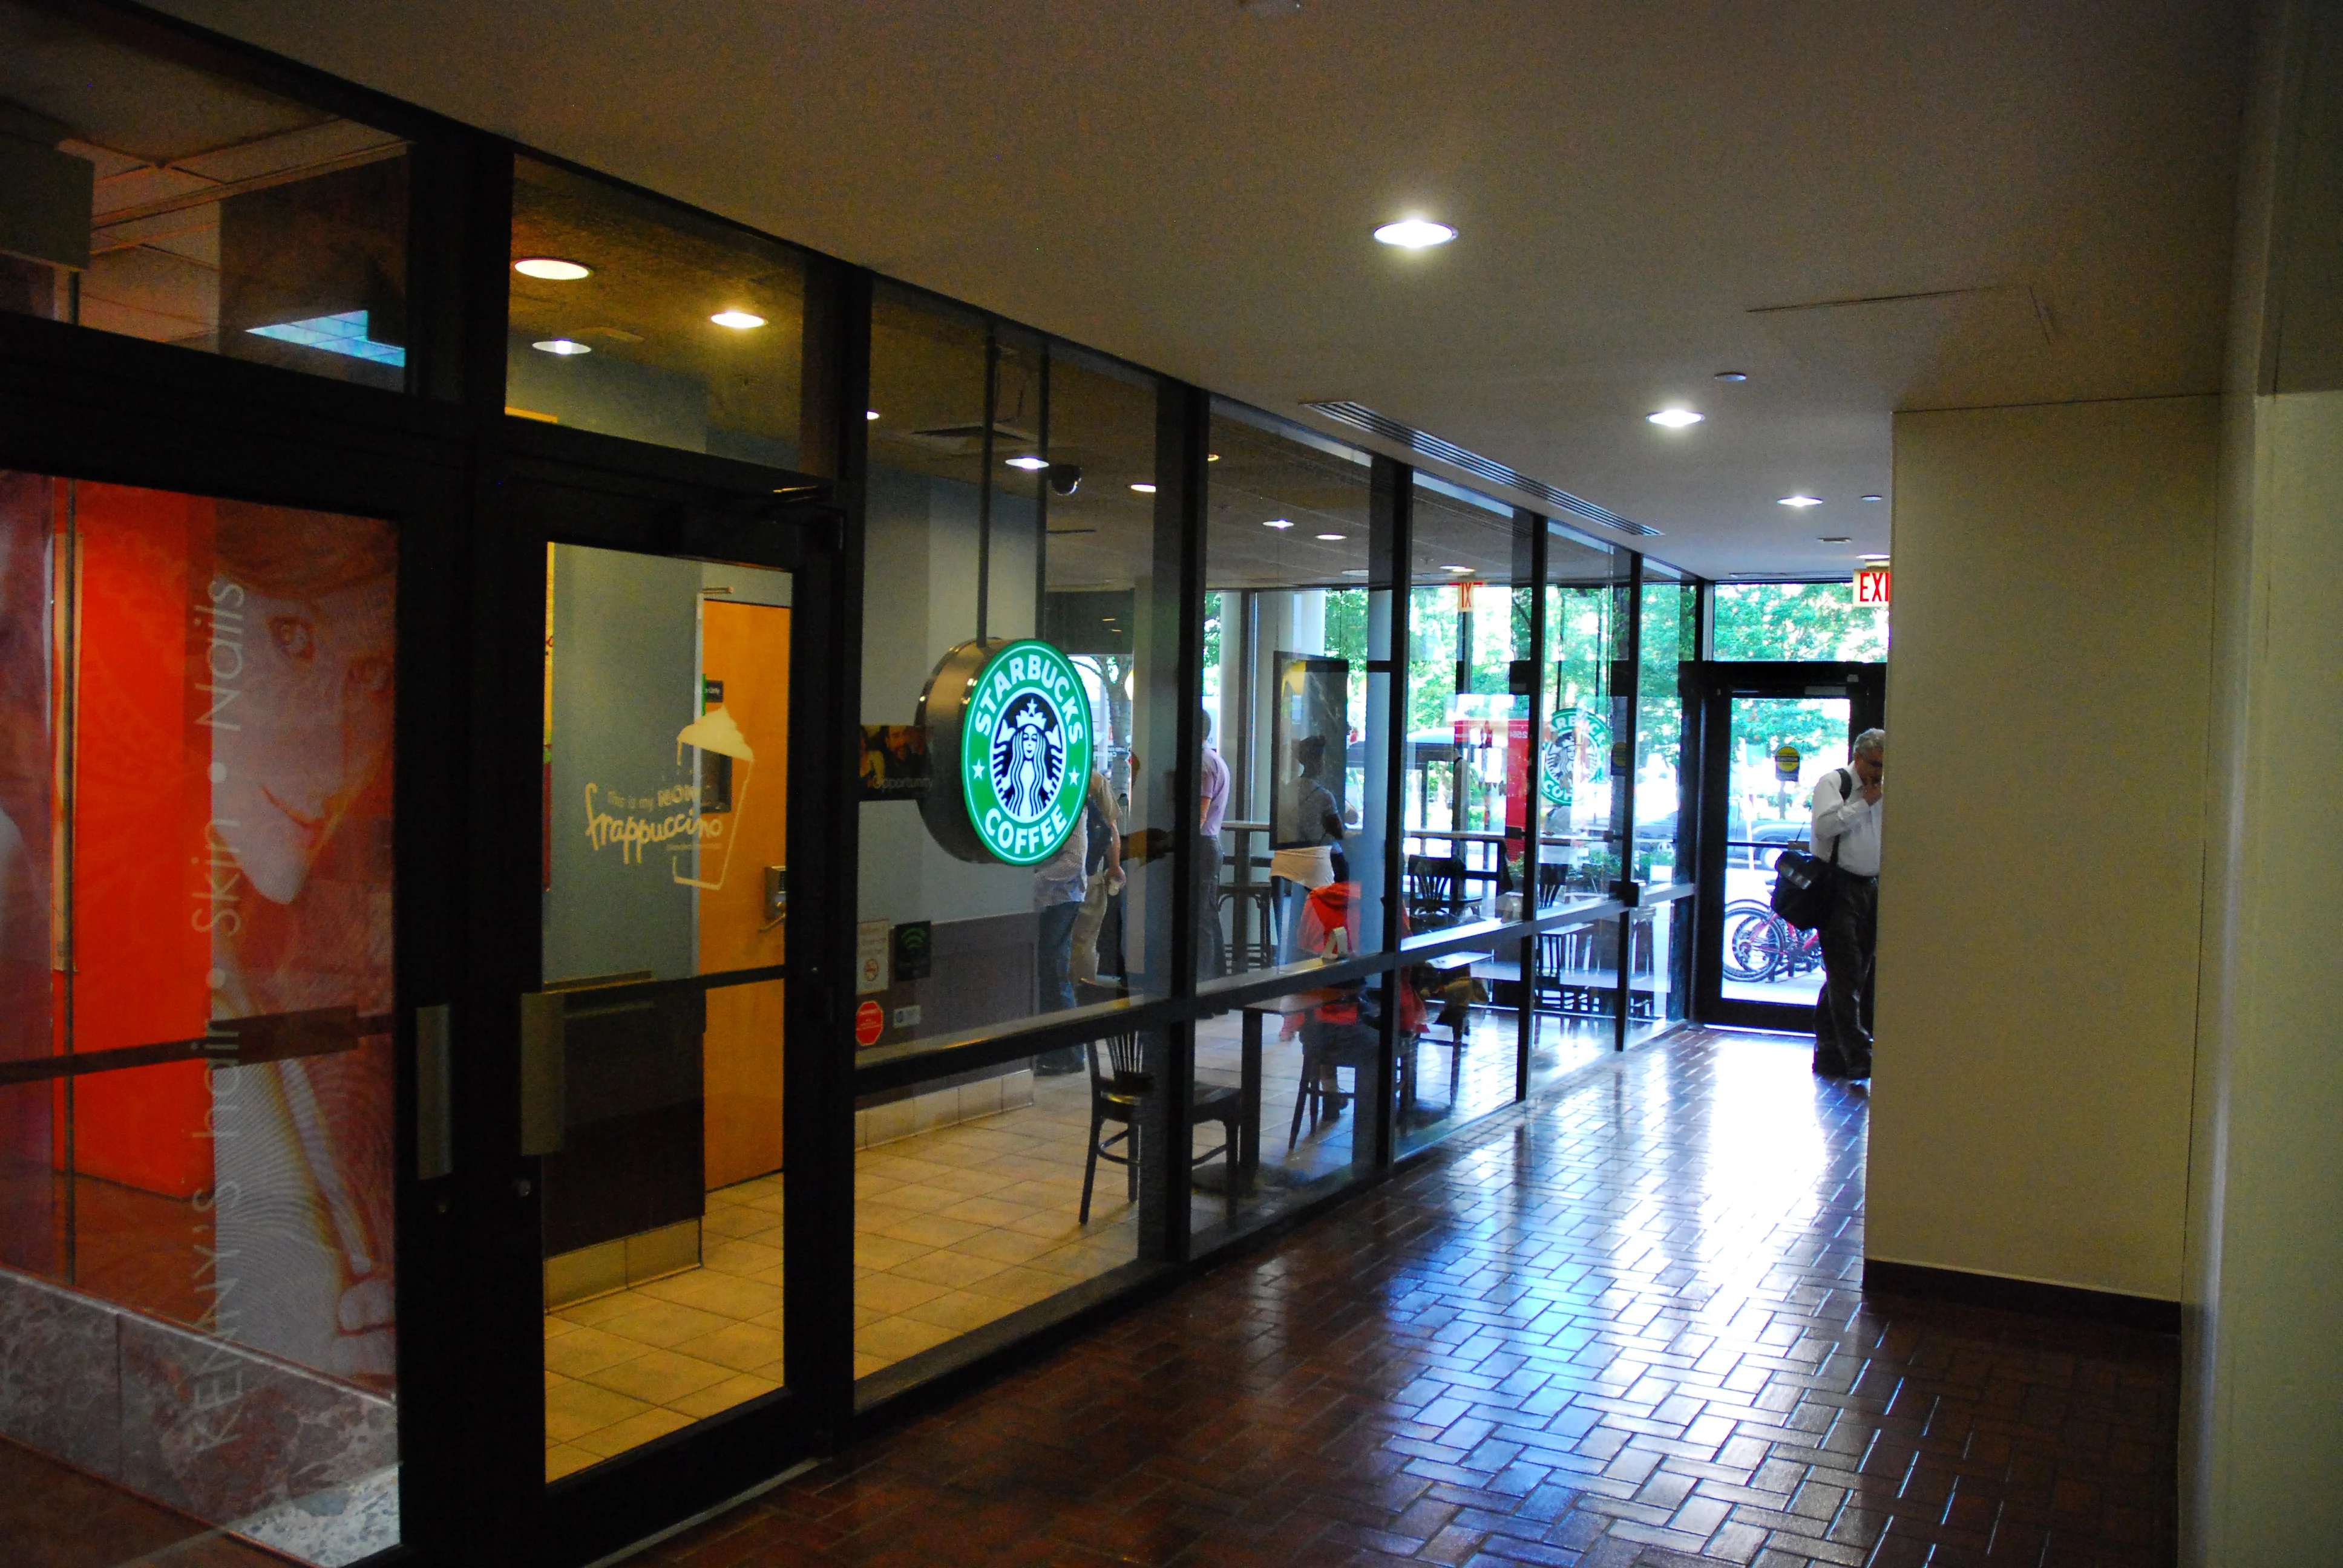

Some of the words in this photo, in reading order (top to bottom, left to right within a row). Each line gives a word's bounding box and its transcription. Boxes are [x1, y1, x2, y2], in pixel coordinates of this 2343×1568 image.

[1860, 572, 1890, 602] EXI
[195, 584, 244, 732] Nails
[975, 654, 1083, 744] STARBUCKS
[586, 782, 724, 865] frappuccino
[985, 803, 1067, 854] COFFEE
[191, 818, 241, 933] Skin
[190, 1019, 240, 1138] hair
[191, 1180, 243, 1454] KENNY'S
